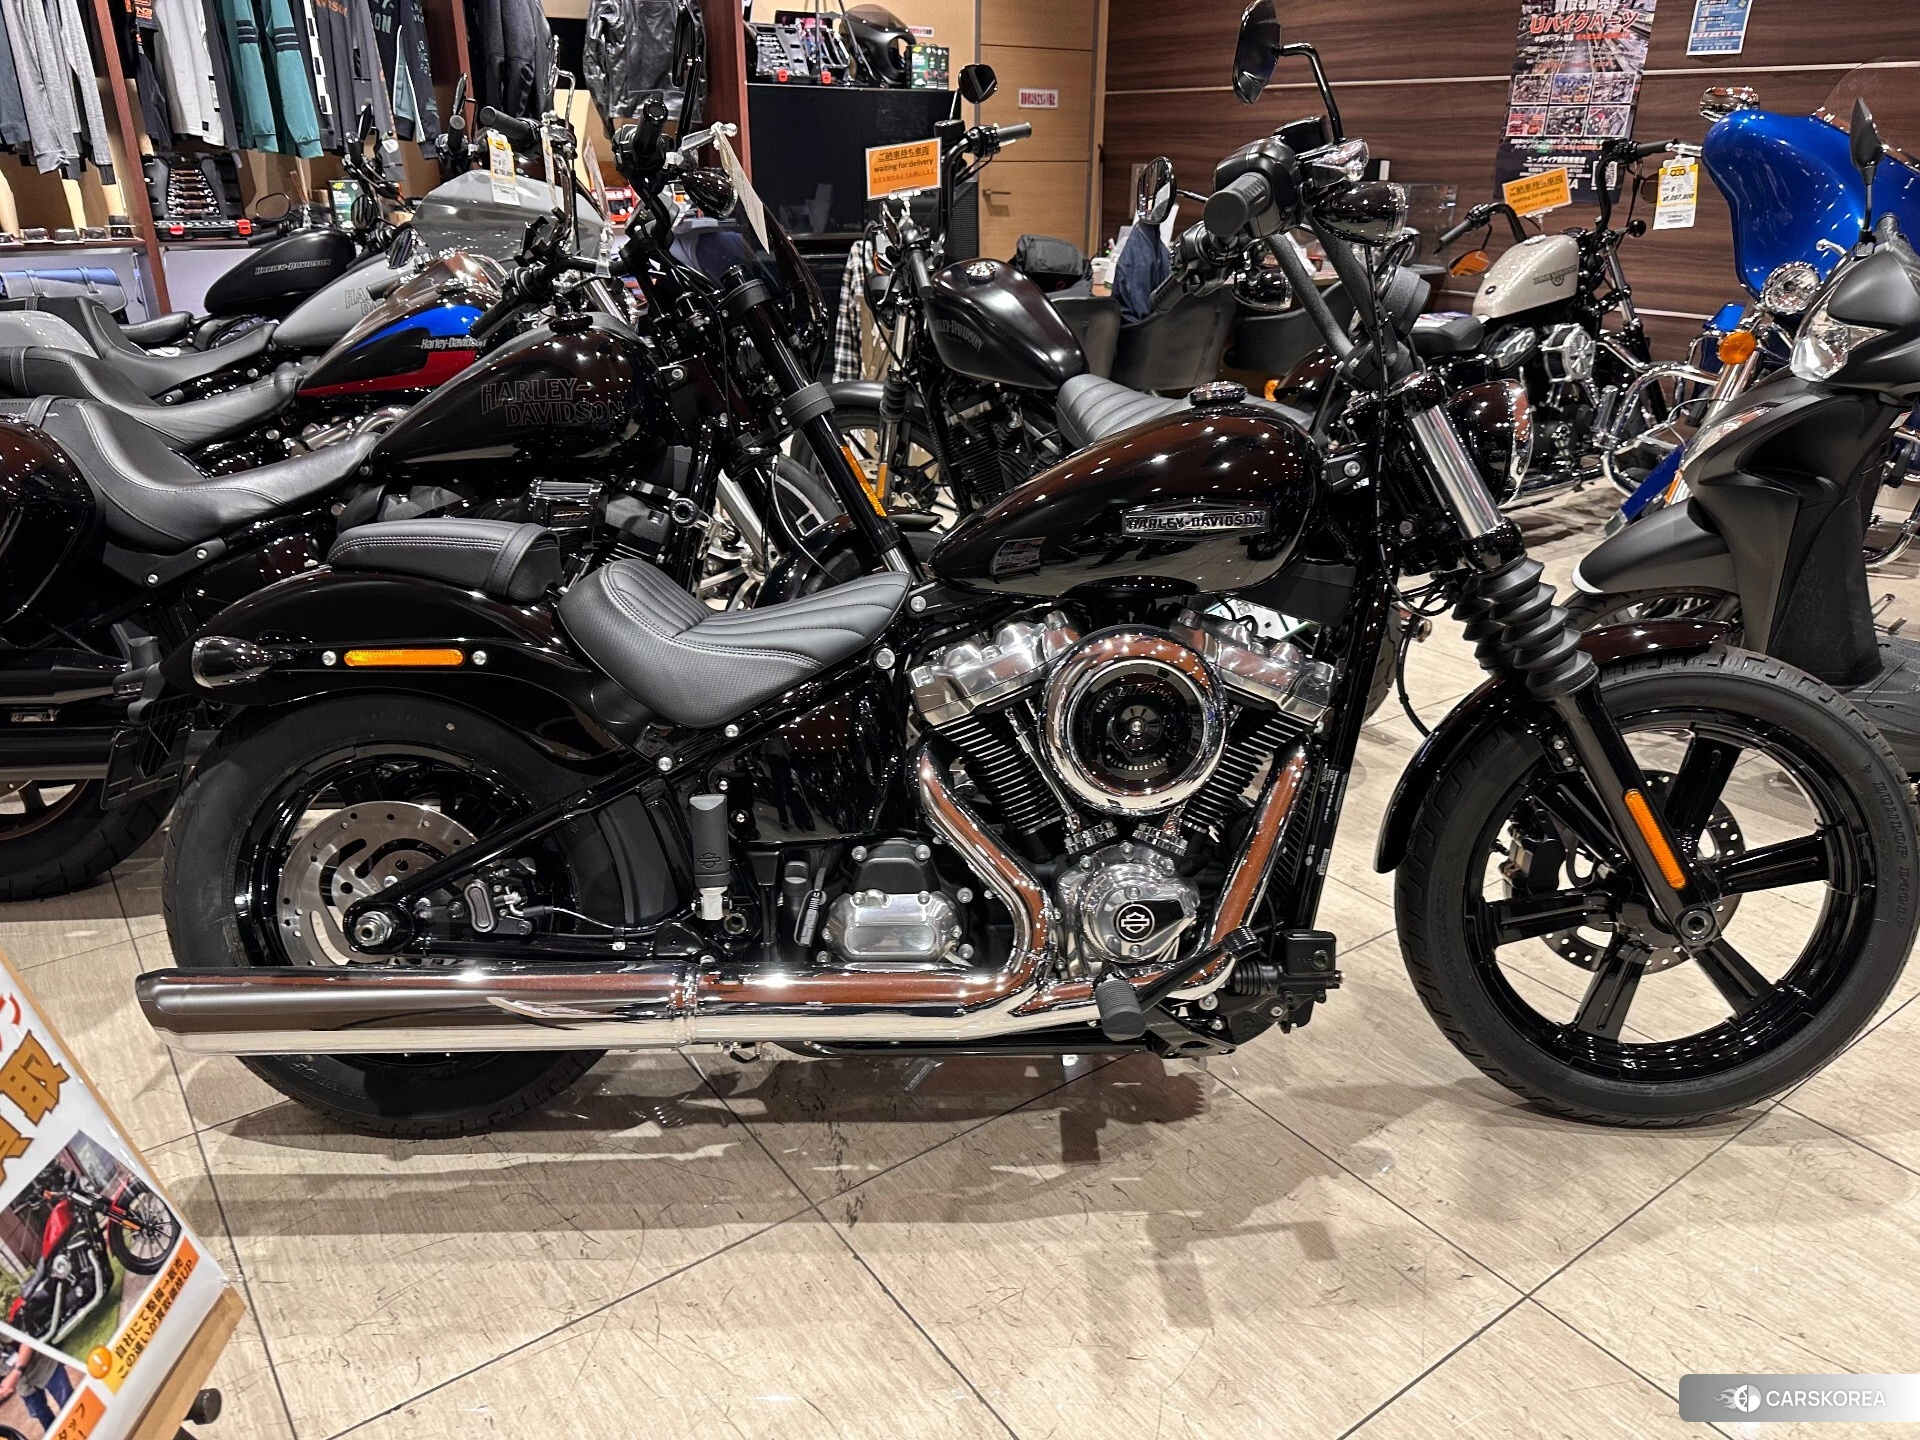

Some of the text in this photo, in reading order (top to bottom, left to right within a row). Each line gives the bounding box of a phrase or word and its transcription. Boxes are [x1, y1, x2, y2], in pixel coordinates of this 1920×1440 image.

[873, 158, 934, 173] waiting for delivery
[254, 258, 332, 276] HARLEY-DAVIDSON
[480, 377, 592, 416] HARLEY-
[505, 400, 626, 427] DAVIDSON
[1126, 511, 1265, 531] HARLEY-DAVIDSON
[1872, 781, 1910, 859] DUNLOP
